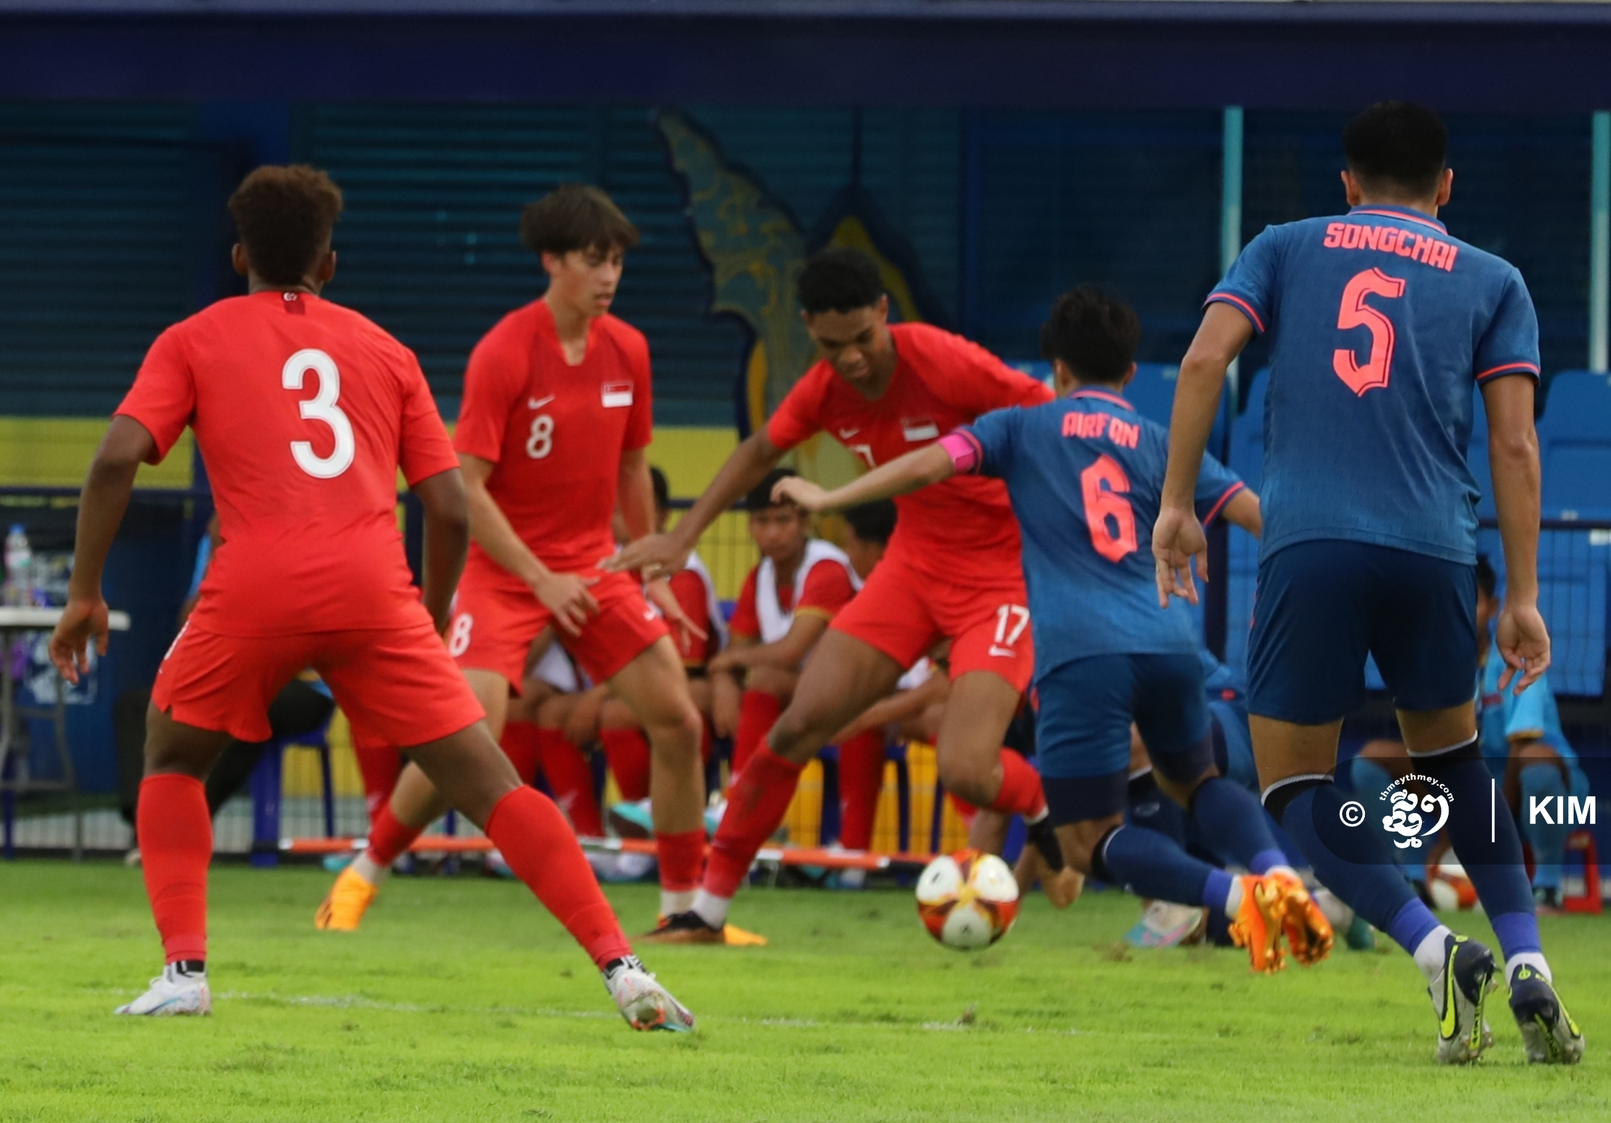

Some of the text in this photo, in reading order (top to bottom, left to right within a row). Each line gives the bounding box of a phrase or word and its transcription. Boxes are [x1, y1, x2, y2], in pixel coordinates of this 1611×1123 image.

[1323, 222, 1459, 272] SONGCHAI
[1333, 267, 1406, 397] 5
[281, 348, 355, 479] 3
[526, 414, 554, 459] 8
[1080, 453, 1138, 563] 6
[449, 612, 473, 658] 8
[996, 604, 1030, 647] 17
